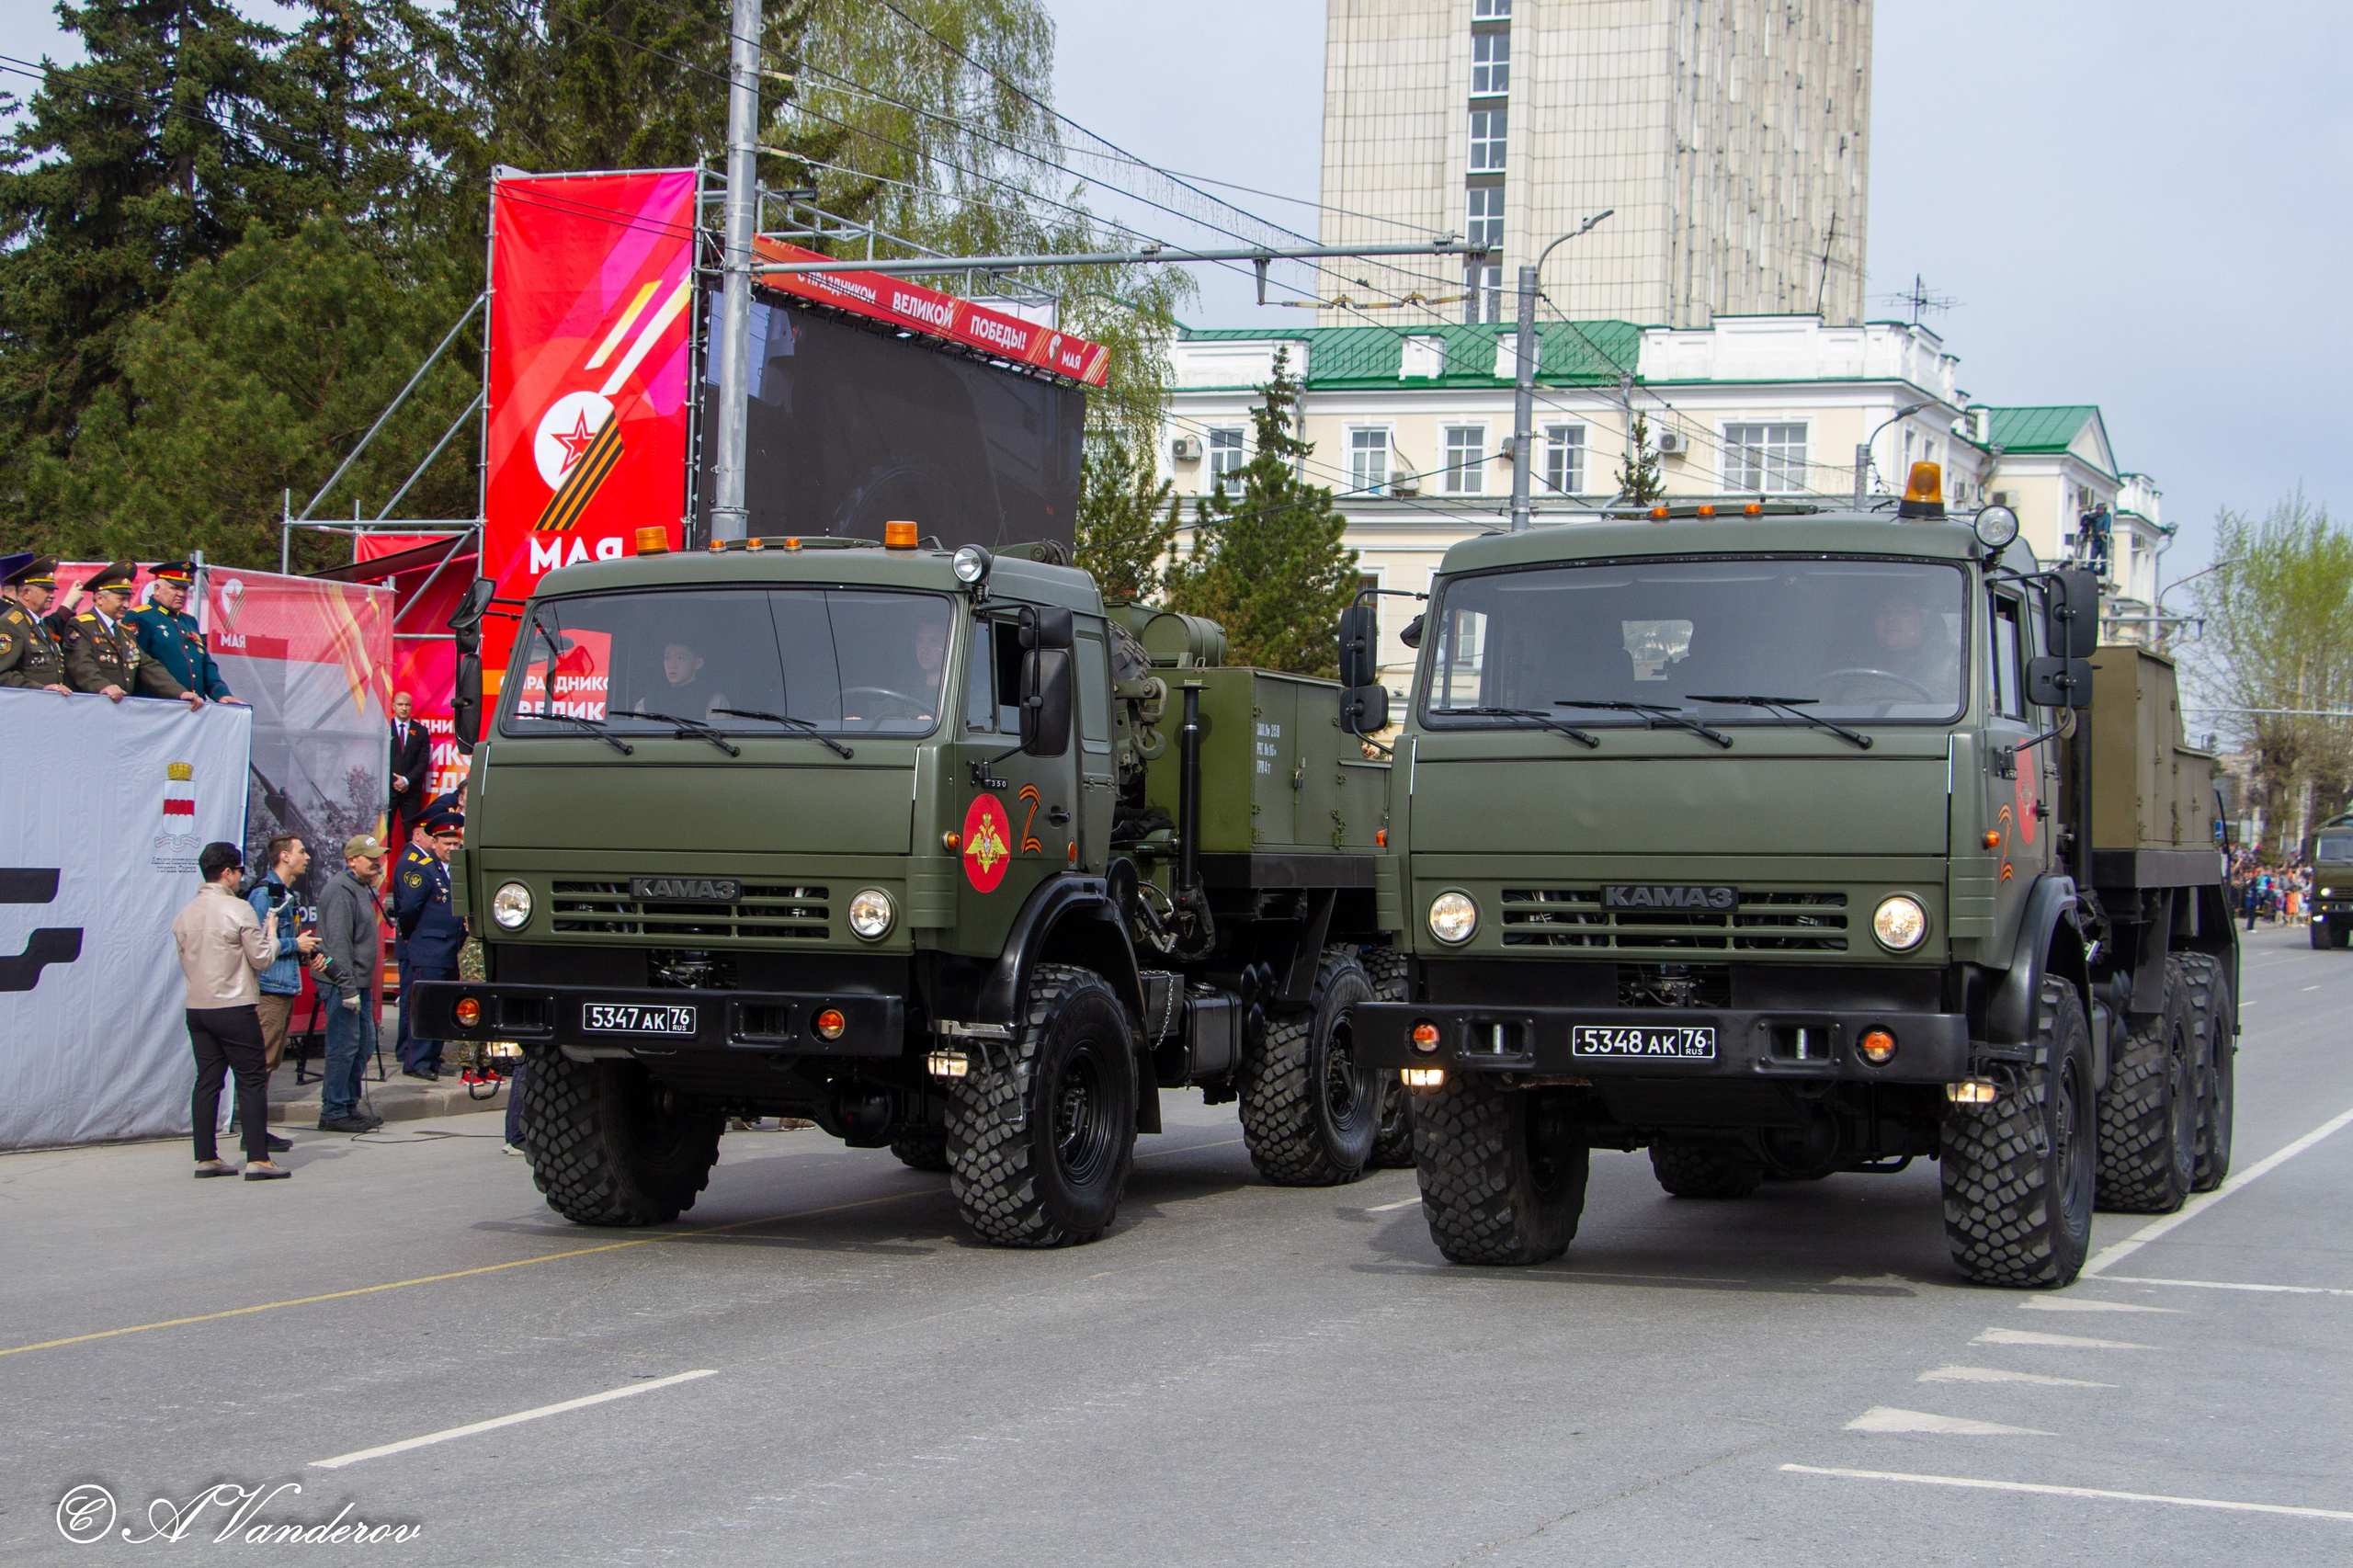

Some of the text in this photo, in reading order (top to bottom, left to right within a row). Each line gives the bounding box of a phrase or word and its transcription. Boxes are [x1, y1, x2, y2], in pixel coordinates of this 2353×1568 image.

[807, 271, 877, 304] ПРАЗДНИКОМ
[892, 291, 954, 328] ВЕЛИКОЙ
[970, 315, 1027, 350] ПОБЕДЫ!
[1062, 350, 1082, 369] МАЯ
[530, 537, 623, 574] МАЯ
[221, 632, 246, 648] МАЯ
[632, 879, 736, 900] КАМАЗ
[1606, 886, 1733, 909] КАМАЗ
[592, 1006, 639, 1028] 5347
[670, 1008, 690, 1025] 76
[1585, 1029, 1643, 1053] 5348
[1682, 1030, 1707, 1049] 76
